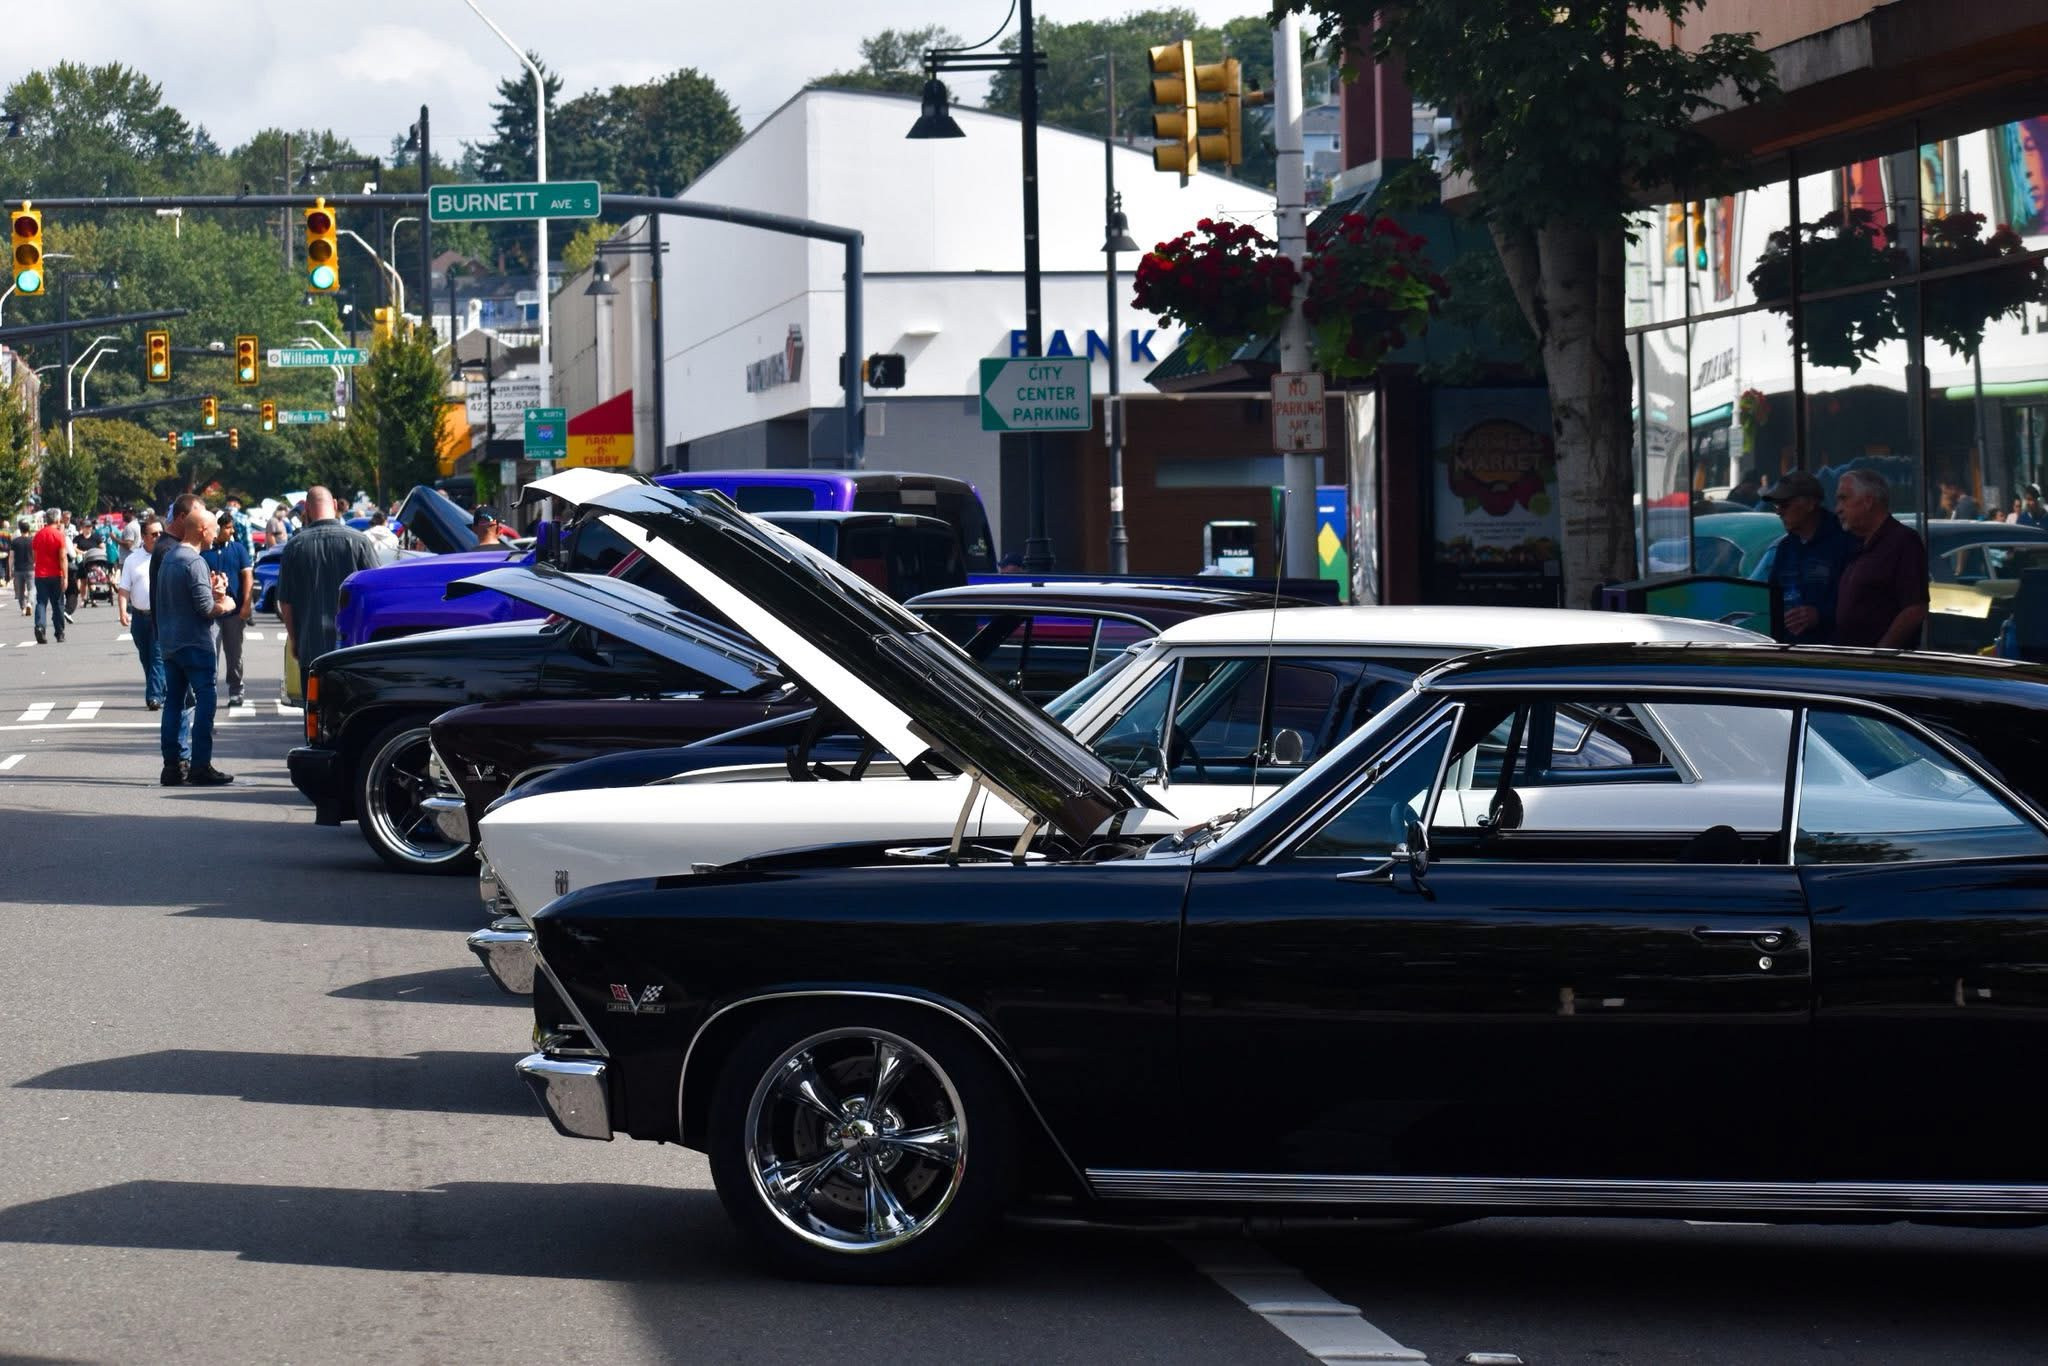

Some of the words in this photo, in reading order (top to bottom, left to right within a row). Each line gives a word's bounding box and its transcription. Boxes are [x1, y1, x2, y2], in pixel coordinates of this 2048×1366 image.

[438, 192, 539, 213] BURNETT
[551, 199, 572, 209] AVE
[583, 198, 592, 209] S
[282, 351, 329, 364] Williams
[333, 350, 355, 364] Ave
[359, 350, 367, 363] S
[1028, 367, 1063, 381] CITY
[1017, 387, 1076, 401] CENTER
[1288, 382, 1308, 396] NO
[1013, 407, 1080, 421] PARKING
[1274, 401, 1322, 416] PARKING
[1288, 419, 1310, 430] ANY
[583, 455, 620, 465] CURRY
